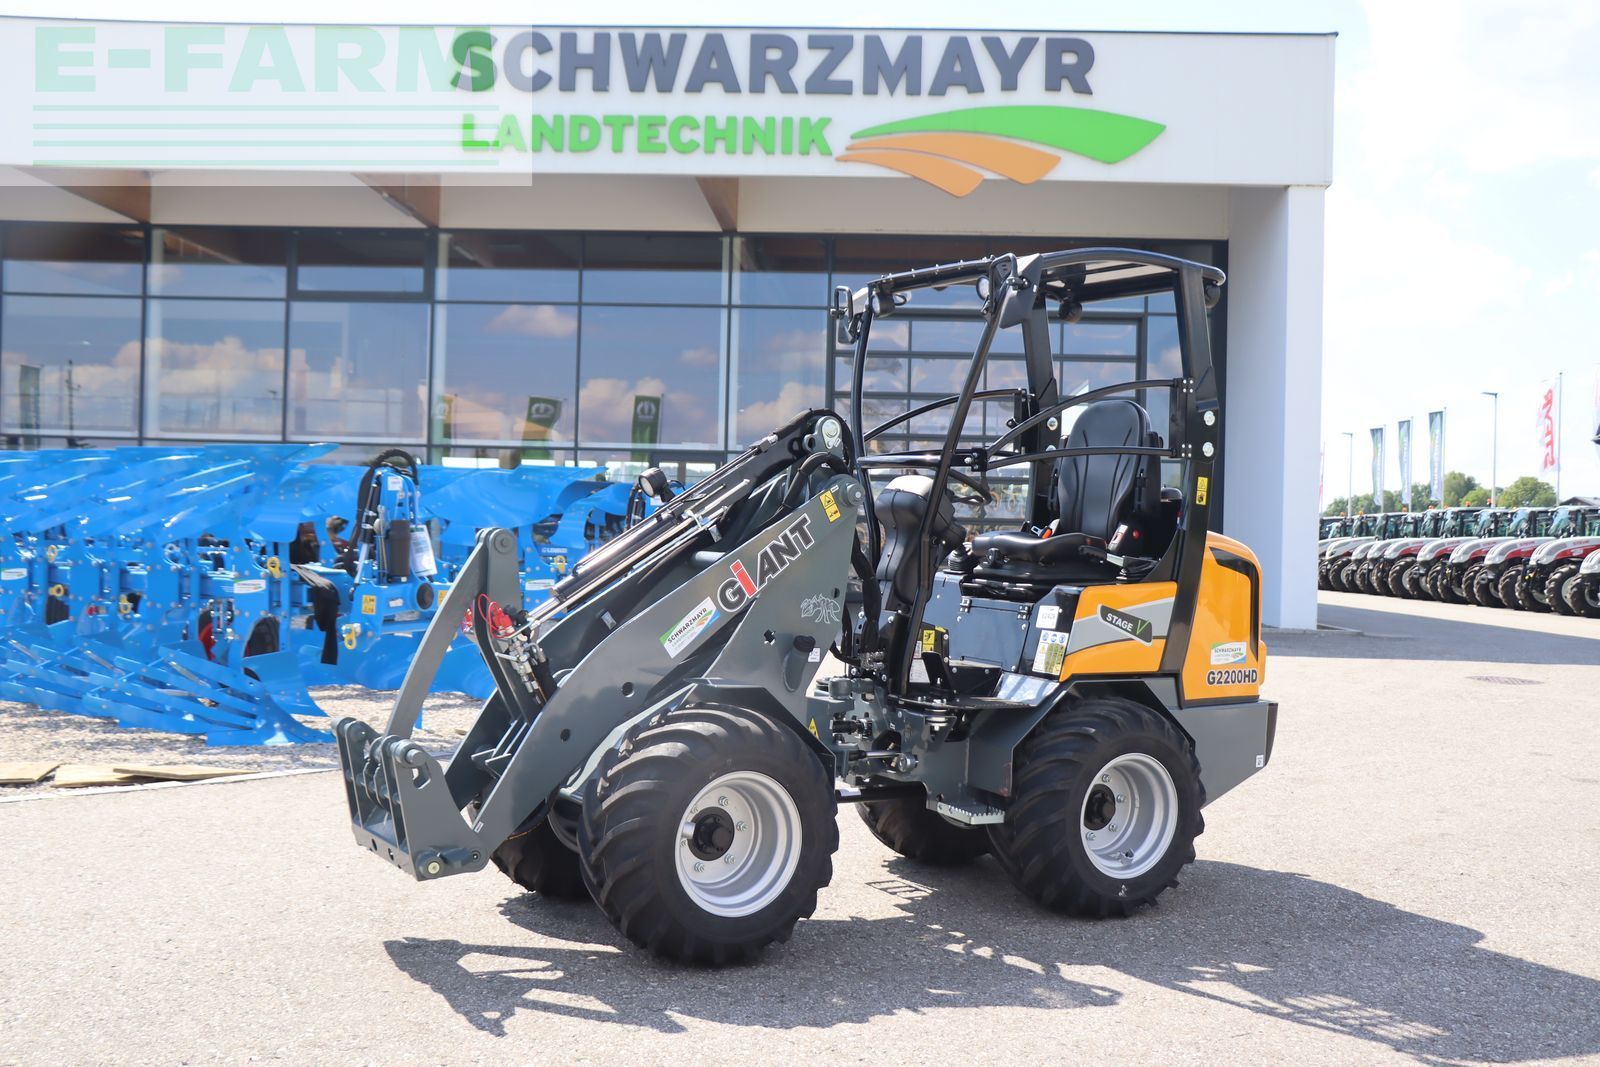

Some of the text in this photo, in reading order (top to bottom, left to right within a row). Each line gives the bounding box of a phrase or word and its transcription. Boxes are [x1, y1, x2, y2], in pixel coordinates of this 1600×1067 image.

[450, 30, 1095, 97] SCHWARZMAYR
[461, 113, 833, 156] LANDTECHNIK
[1106, 612, 1151, 636] STAGE V
[1207, 668, 1258, 686] G2200HD
